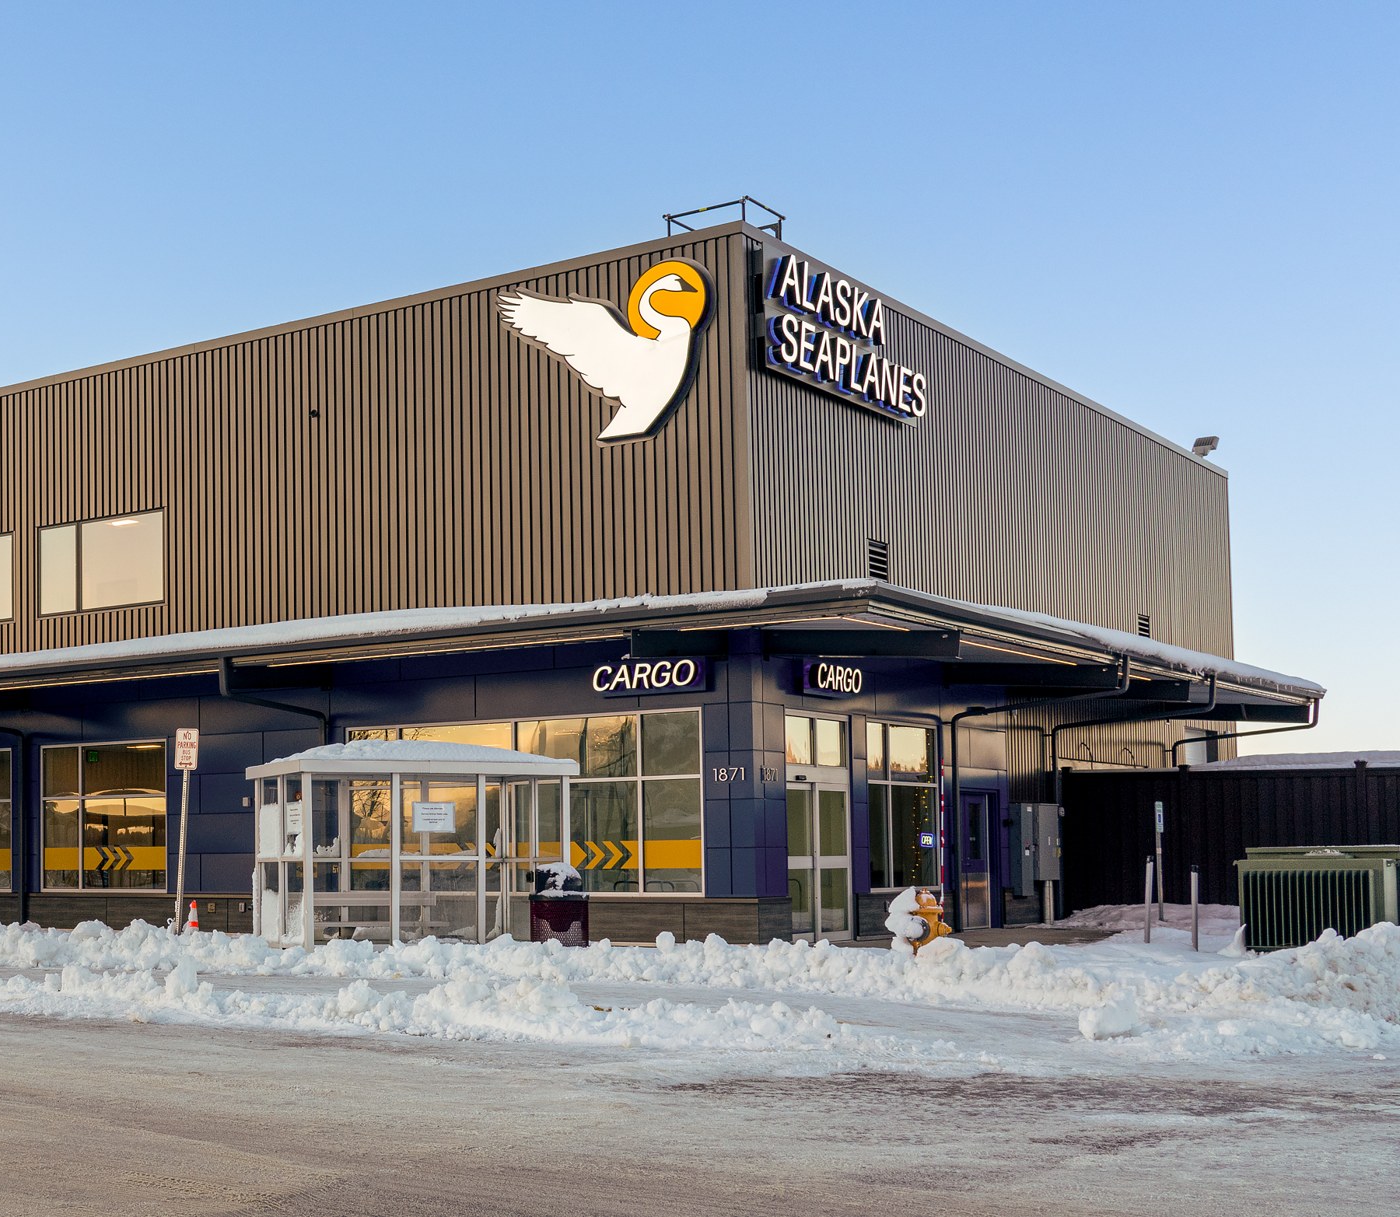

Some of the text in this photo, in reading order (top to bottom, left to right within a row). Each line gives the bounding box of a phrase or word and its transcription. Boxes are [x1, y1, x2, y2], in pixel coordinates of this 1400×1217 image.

[780, 254, 885, 345] ALASKA
[781, 314, 926, 417] SEAPLANES
[592, 659, 695, 692] CARGO
[817, 662, 862, 693] CARGO
[183, 731, 191, 740] NO
[712, 767, 745, 781] 1871
[762, 767, 779, 781] 1871
